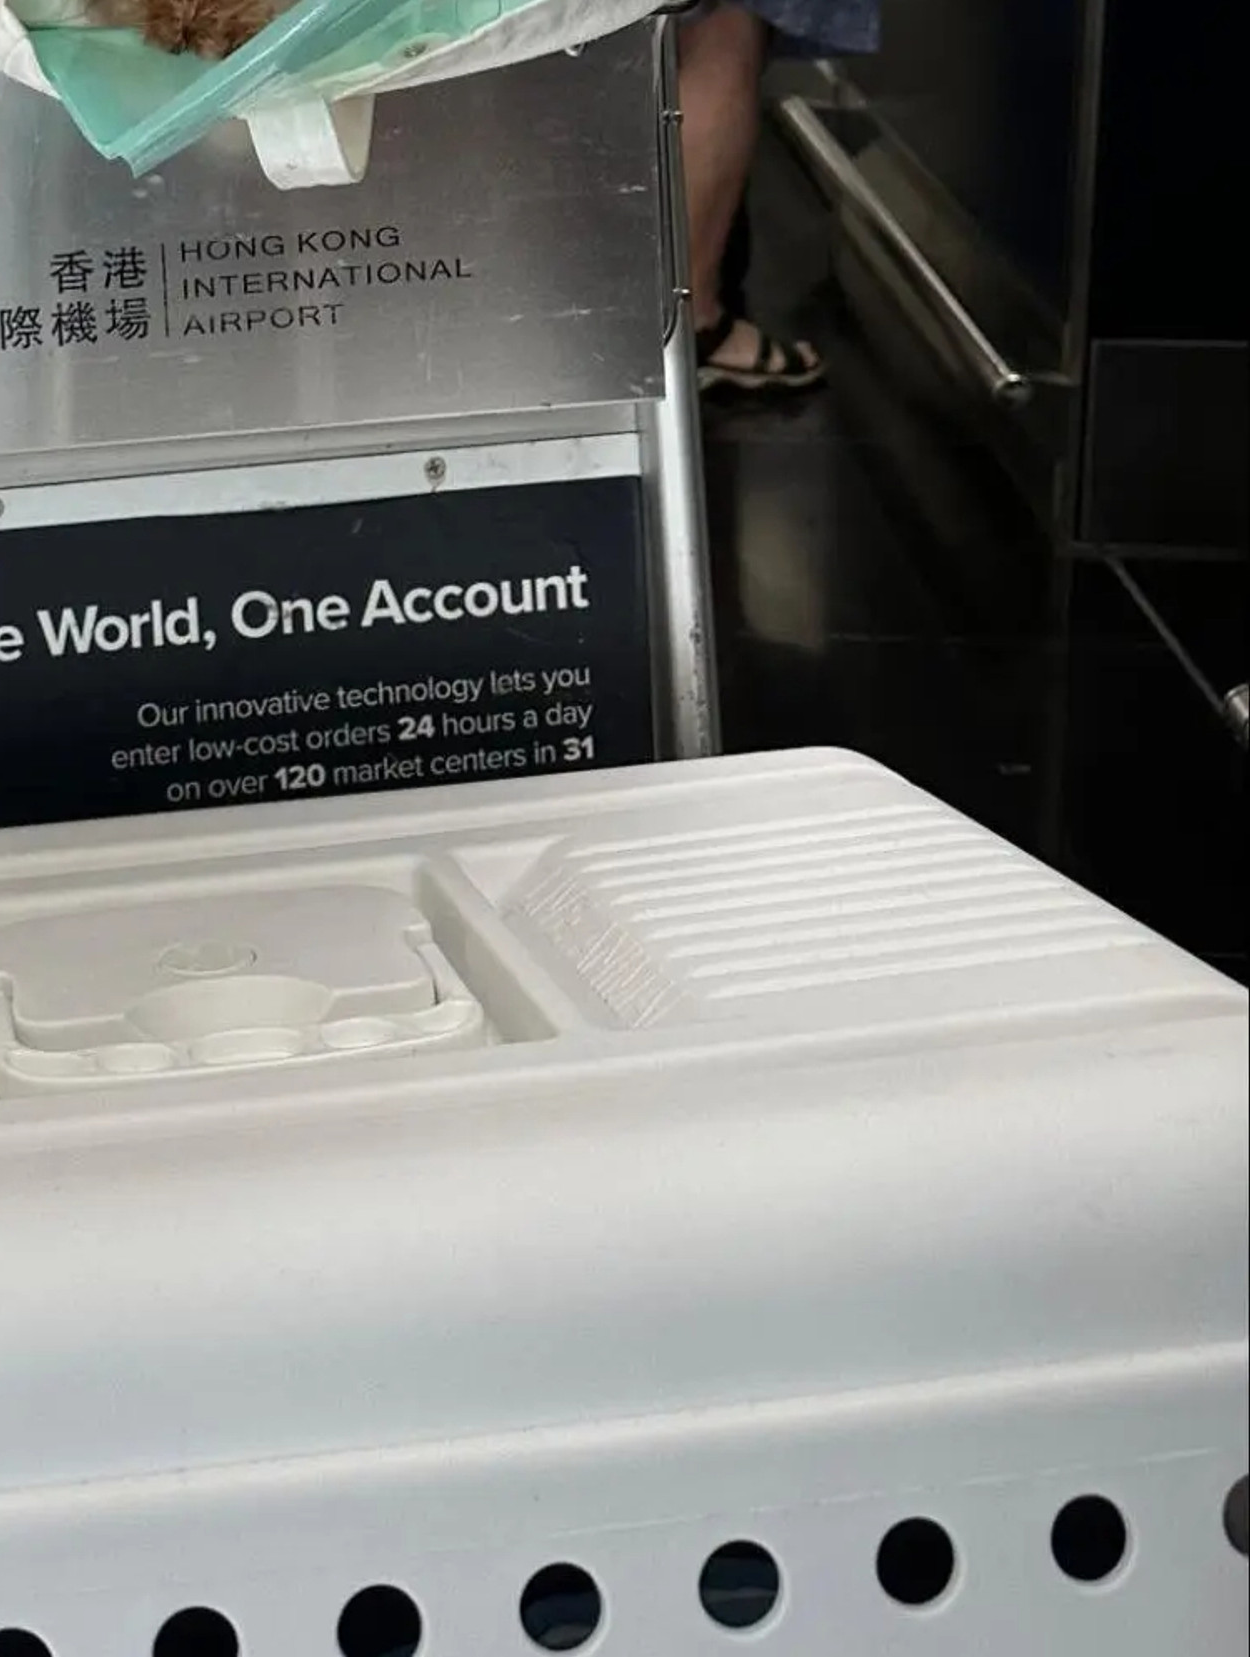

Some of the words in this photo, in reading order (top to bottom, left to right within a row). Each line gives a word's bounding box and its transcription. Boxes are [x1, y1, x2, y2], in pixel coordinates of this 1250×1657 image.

[50, 246, 148, 294] 香港
[180, 235, 285, 262] HONG
[298, 226, 401, 254] KONG
[183, 258, 472, 300] INTERNATIONAL
[183, 303, 344, 336] AIRPORT
[37, 596, 217, 657] World,
[231, 590, 351, 639] One
[361, 565, 590, 628] Account
[137, 702, 189, 728] Our
[195, 689, 331, 724] innovative
[336, 675, 484, 709] technology
[490, 669, 537, 694] lets
[542, 667, 591, 695] you
[111, 743, 180, 770] enter
[189, 730, 300, 762] low-cost
[306, 722, 392, 750] orders
[397, 713, 435, 740] 24
[442, 710, 517, 737] hours
[523, 709, 538, 728] a
[545, 701, 593, 728] day
[166, 781, 201, 802] on
[208, 773, 270, 798] over
[275, 763, 327, 790] 120
[333, 753, 425, 785] market
[430, 746, 527, 775] centers
[534, 740, 557, 764] in
[562, 735, 595, 761] 31
